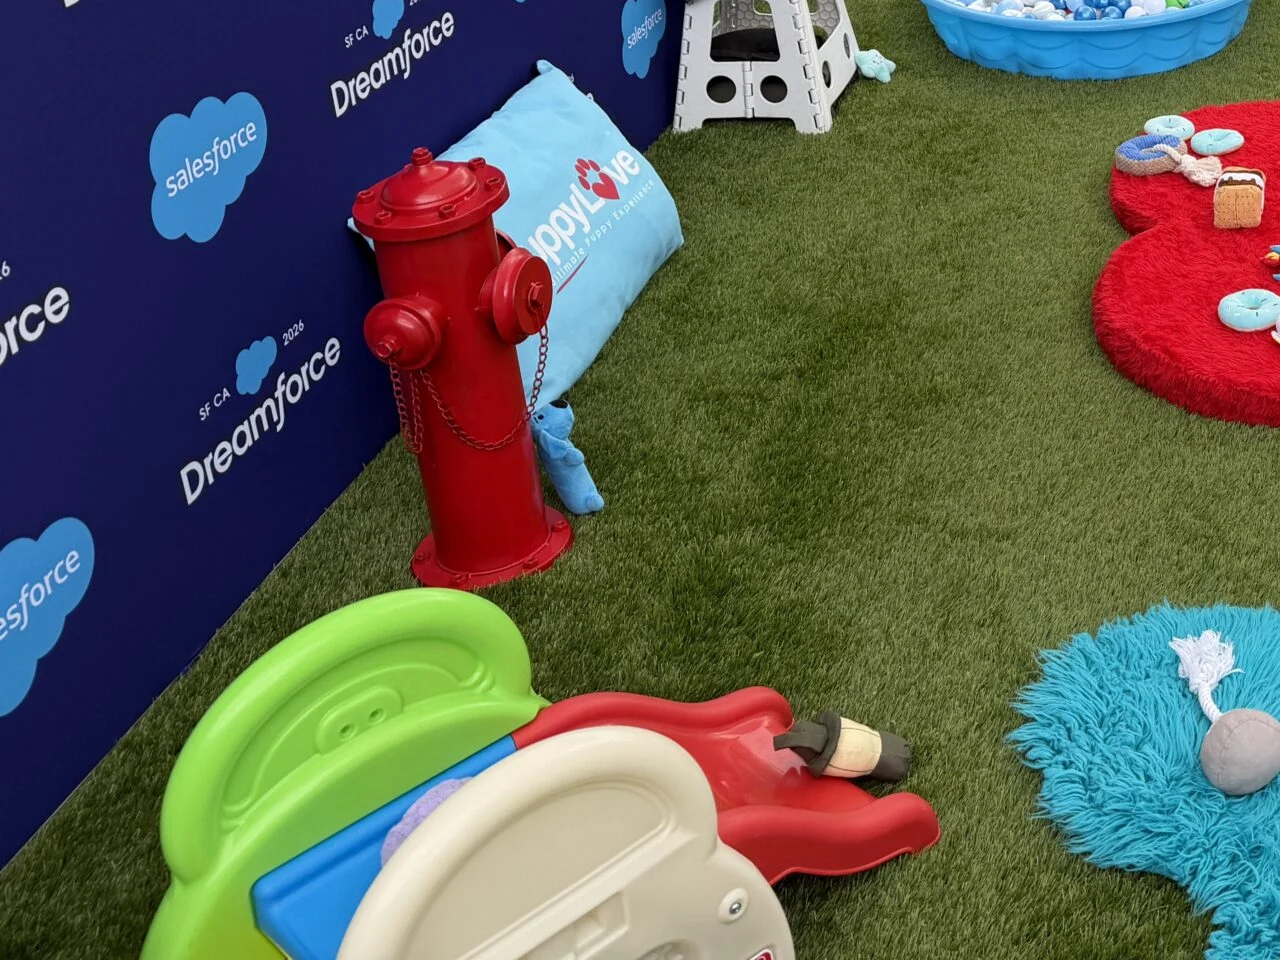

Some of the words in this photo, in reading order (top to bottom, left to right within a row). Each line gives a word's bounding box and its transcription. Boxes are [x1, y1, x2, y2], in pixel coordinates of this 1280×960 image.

[330, 11, 455, 118] Dreamforce
[345, 31, 354, 48] SF
[356, 26, 369, 40] CA
[627, 8, 663, 49] salesforce
[166, 122, 257, 197] salesforce
[528, 150, 640, 266] ppyLove
[552, 247, 585, 286] ltimate
[200, 402, 211, 421] SF
[213, 387, 231, 407] CA
[282, 319, 304, 346] 2026
[180, 337, 340, 505] Dreamforce
[0, 550, 81, 641] esforce
